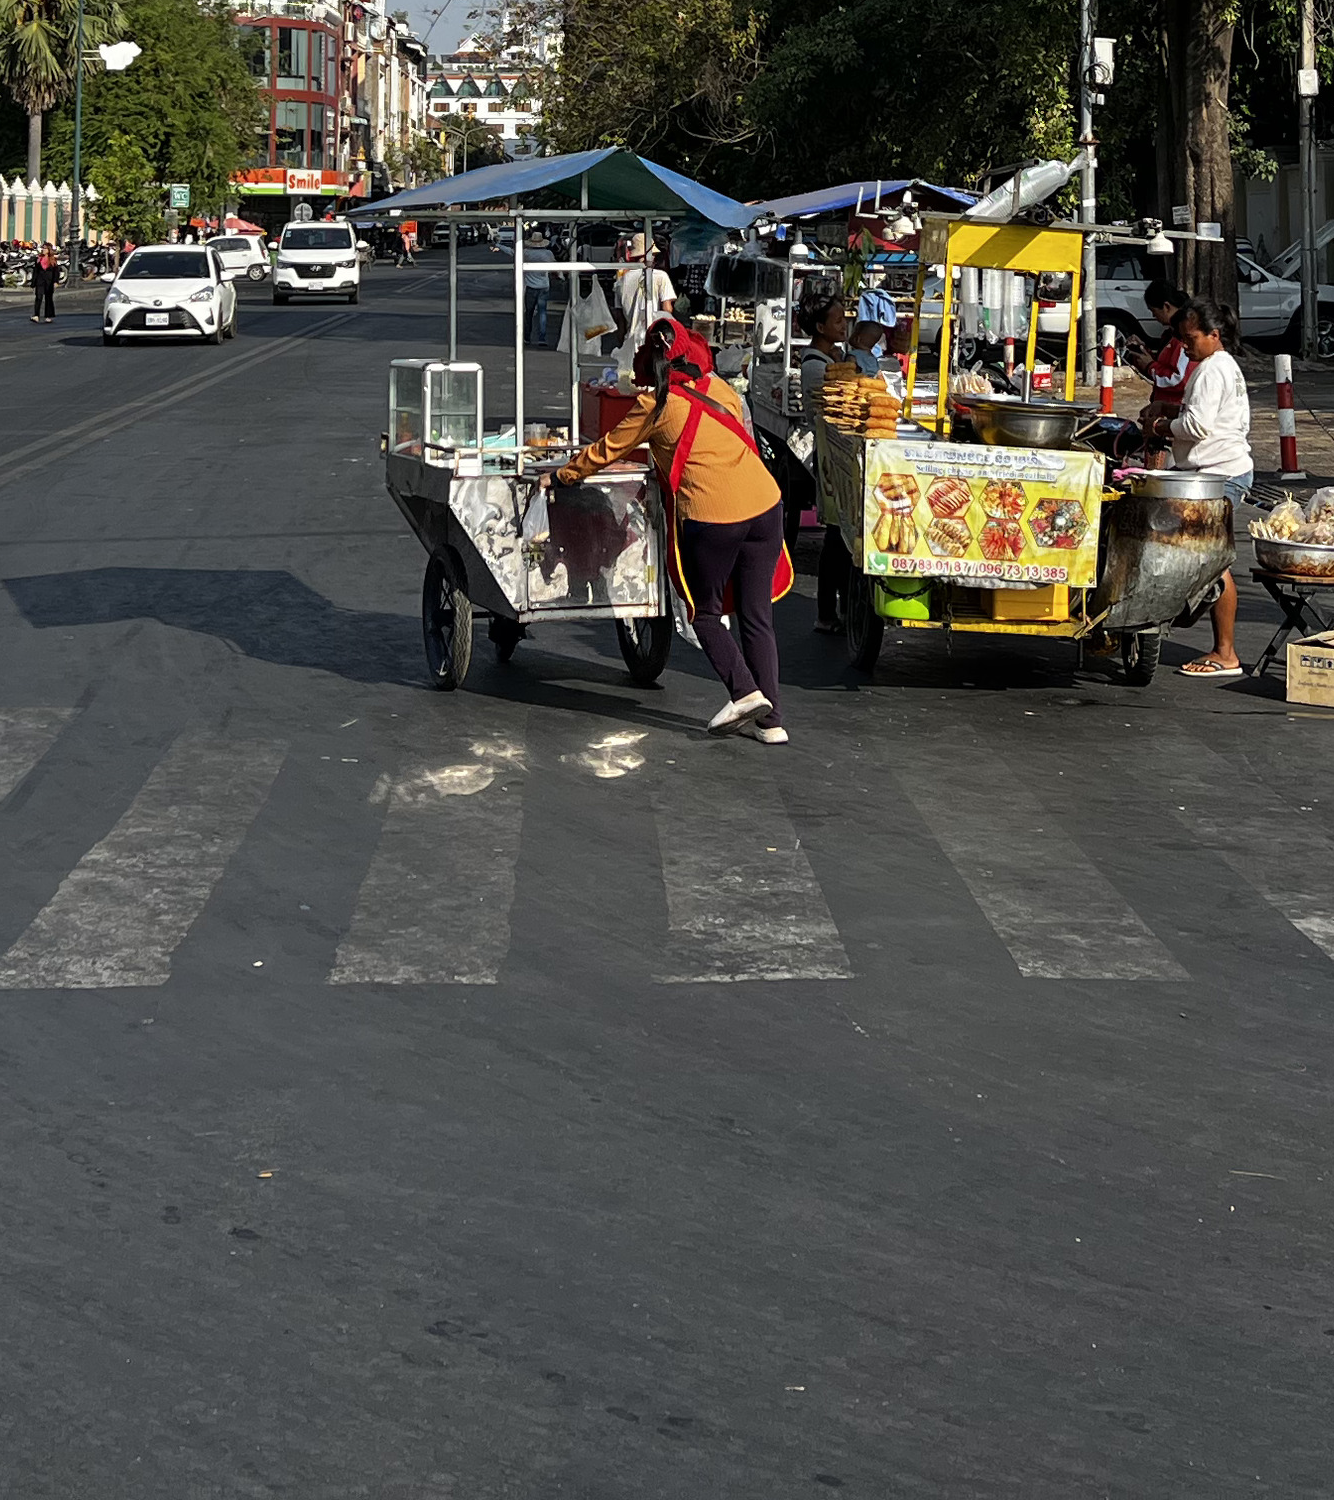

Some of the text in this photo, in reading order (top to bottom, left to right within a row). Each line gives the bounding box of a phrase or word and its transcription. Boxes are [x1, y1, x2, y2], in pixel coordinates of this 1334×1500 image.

[288, 173, 320, 190] Smile
[891, 557, 915, 569] 087
[918, 559, 932, 571] 83
[936, 560, 949, 571] 01
[954, 561, 969, 573] 87
[979, 563, 1002, 575] 096
[1006, 564, 1021, 576] 73
[1024, 566, 1039, 577] 13
[1042, 567, 1066, 579] 385
